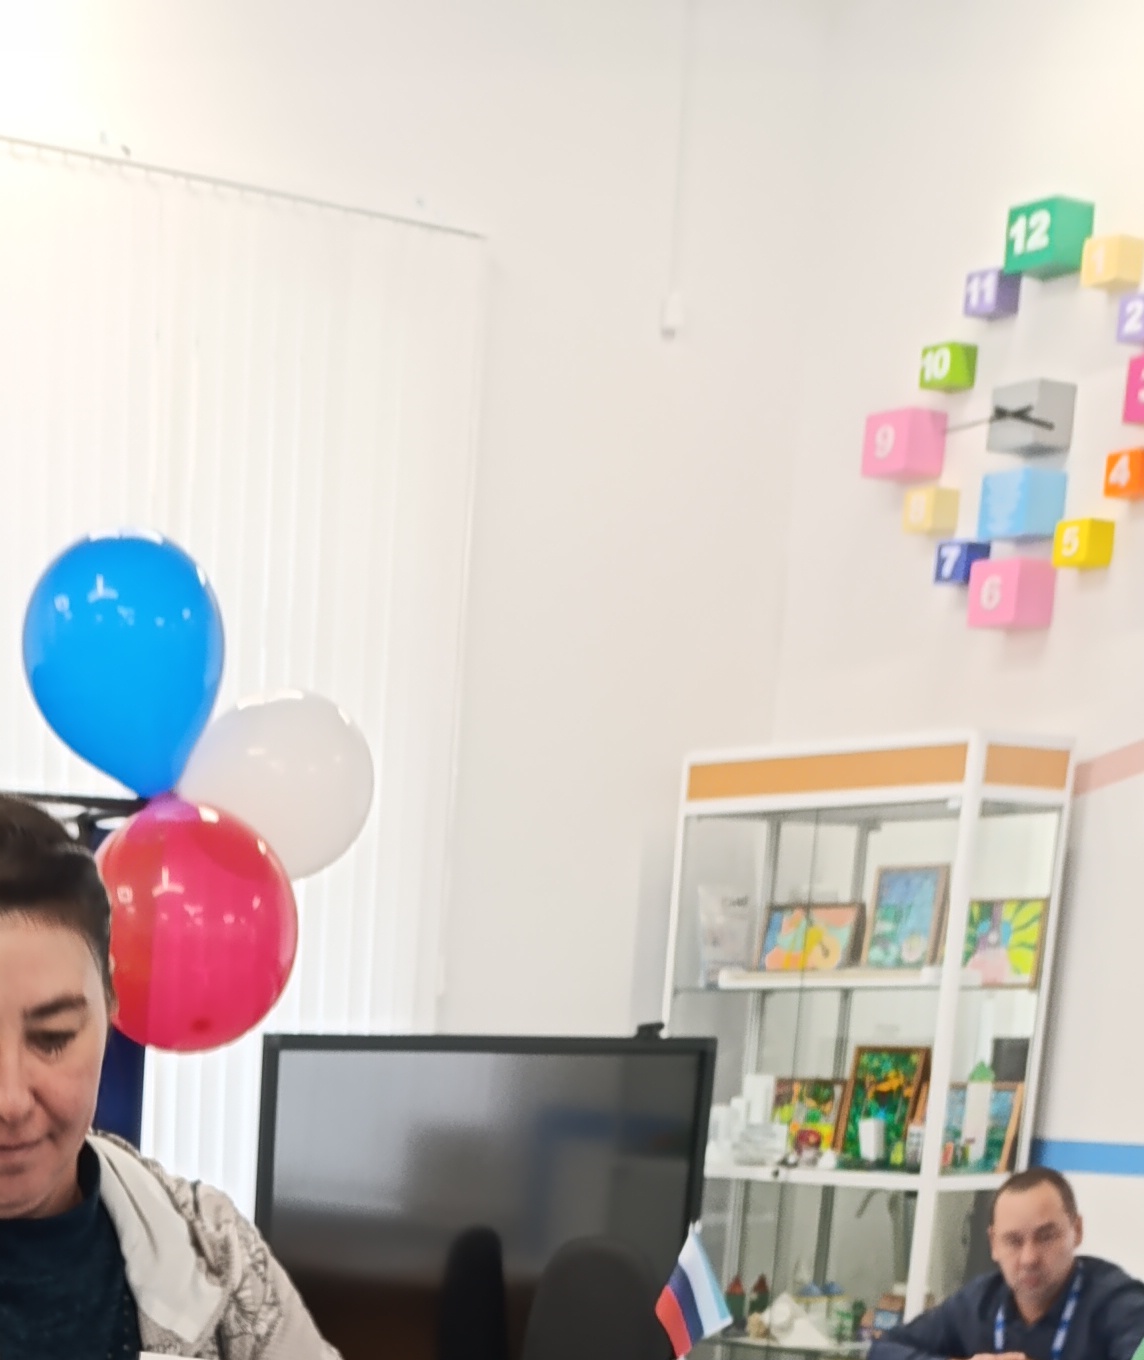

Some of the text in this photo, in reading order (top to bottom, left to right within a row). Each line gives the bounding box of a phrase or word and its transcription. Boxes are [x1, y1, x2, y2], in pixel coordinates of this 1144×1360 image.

[1010, 209, 1051, 256] 12
[1092, 244, 1105, 275] 1
[967, 272, 998, 308] 11
[1122, 300, 1144, 334] 2
[922, 346, 952, 382] 10
[874, 423, 896, 461] 9
[1108, 452, 1131, 488] 4
[1062, 525, 1081, 558] 5
[939, 545, 961, 578] 7
[980, 574, 1002, 611] 6
